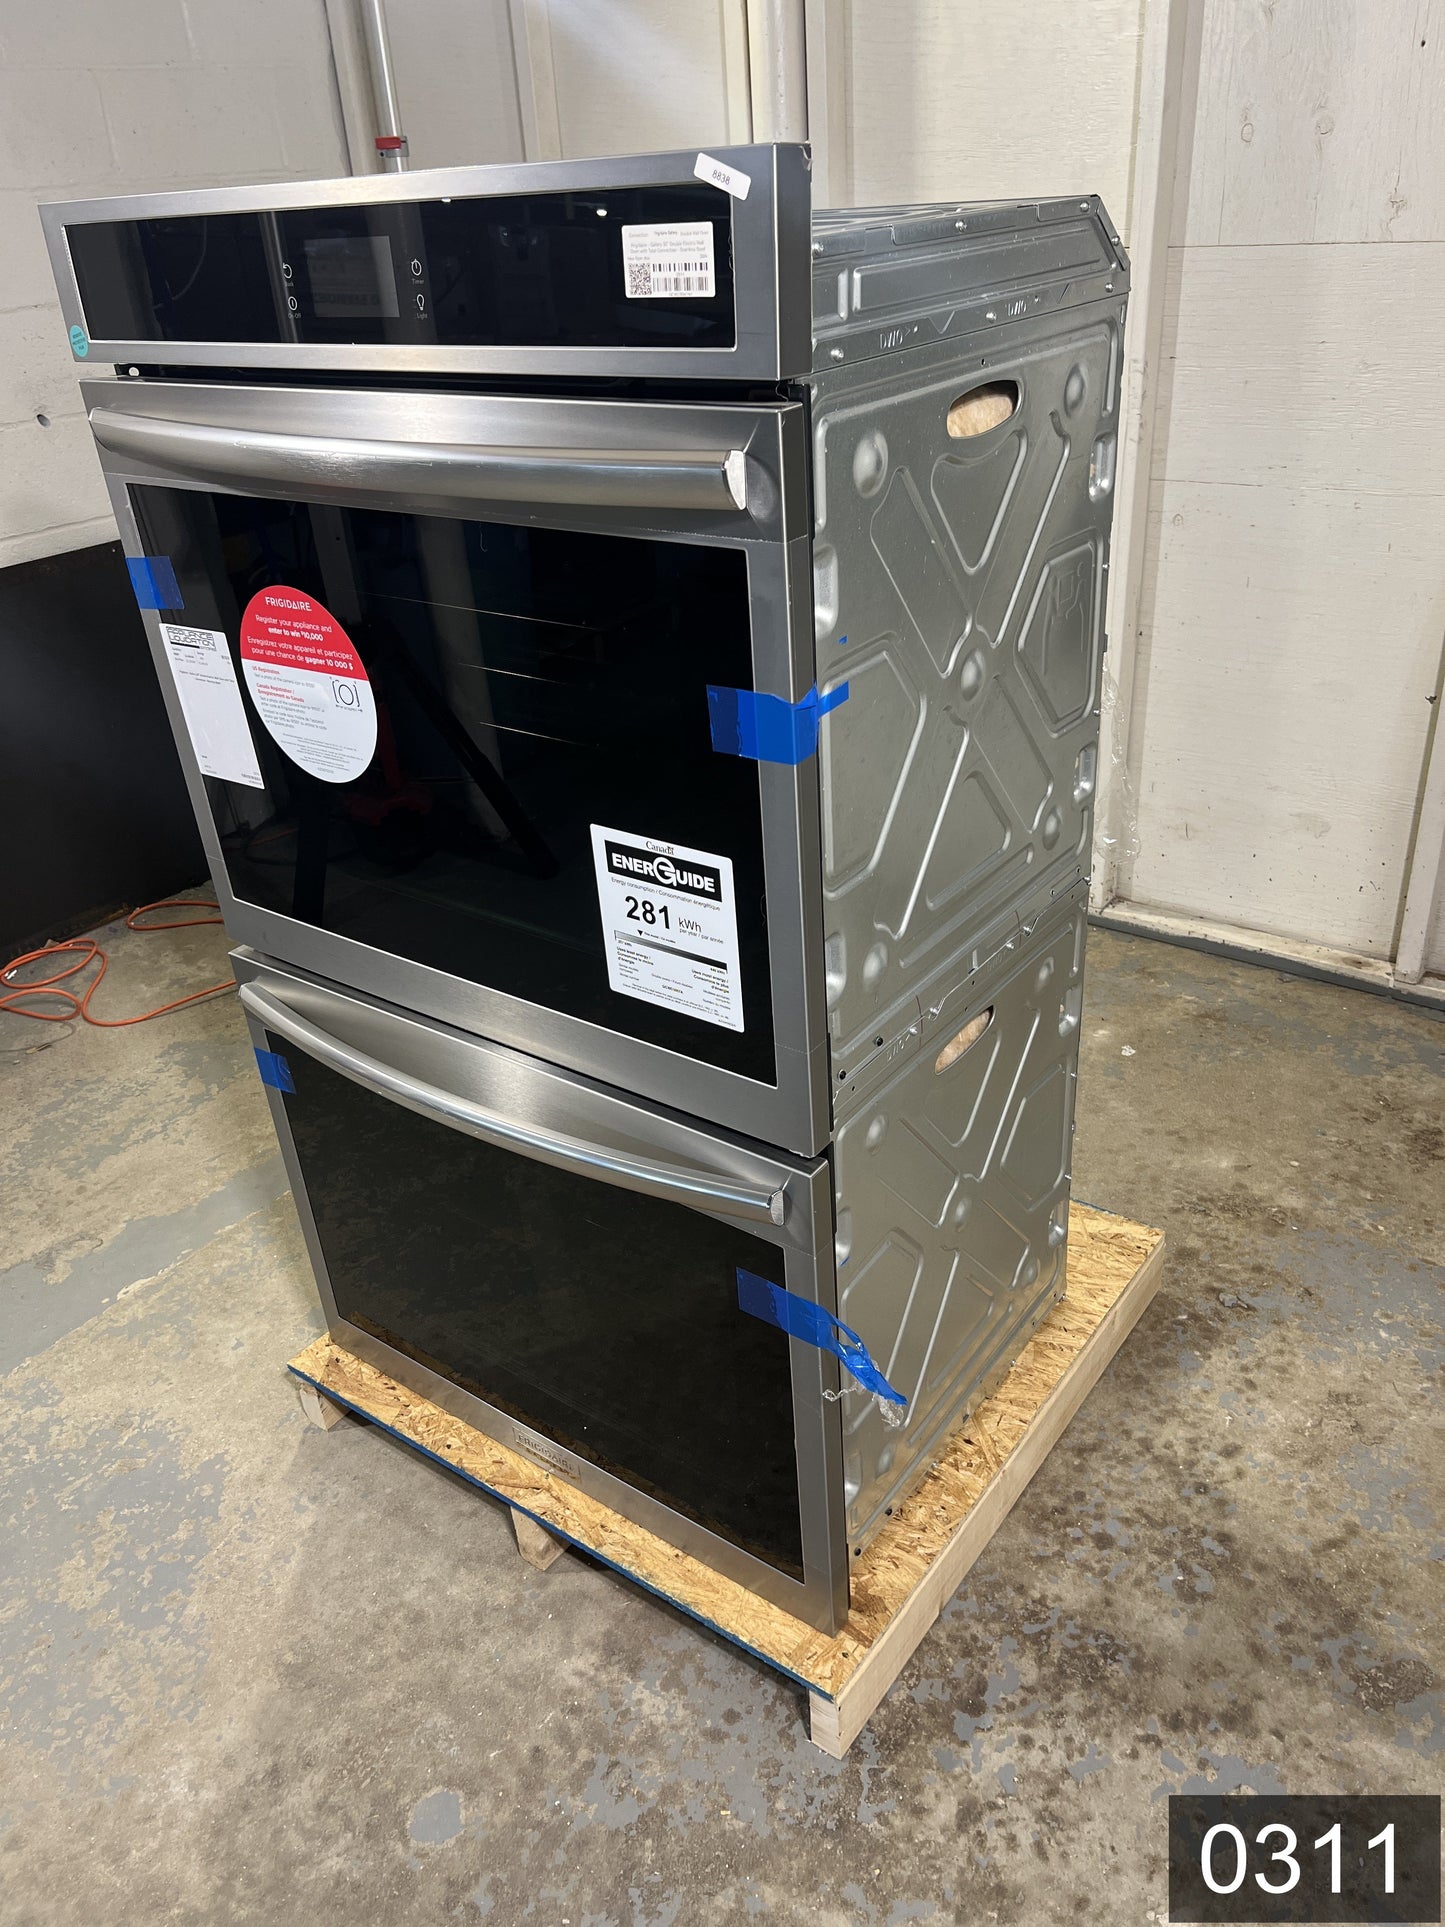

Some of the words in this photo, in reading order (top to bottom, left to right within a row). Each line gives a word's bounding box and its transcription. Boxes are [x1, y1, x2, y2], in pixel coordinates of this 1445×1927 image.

[712, 169, 731, 186] 8838
[265, 596, 312, 612] FRIGIDAIRE
[256, 614, 278, 625] Register
[293, 621, 320, 632] appliance
[321, 624, 332, 632] and
[268, 627, 282, 635] enter
[247, 636, 278, 648] Enregistrez
[294, 644, 316, 654] appareil
[324, 650, 353, 660] participez
[265, 649, 276, 657] une
[276, 650, 296, 660] chance
[297, 653, 305, 661] de
[306, 656, 325, 666] gagner
[334, 661, 348, 669] 000
[349, 662, 354, 671] $
[646, 841, 674, 856] Canada
[612, 852, 716, 893] ENERGUIDE
[611, 877, 626, 887] Energy
[627, 880, 656, 894] consumption
[659, 890, 692, 903] Consommation
[693, 899, 721, 911] énergétique
[625, 896, 670, 930] 281
[678, 918, 702, 932] kWh
